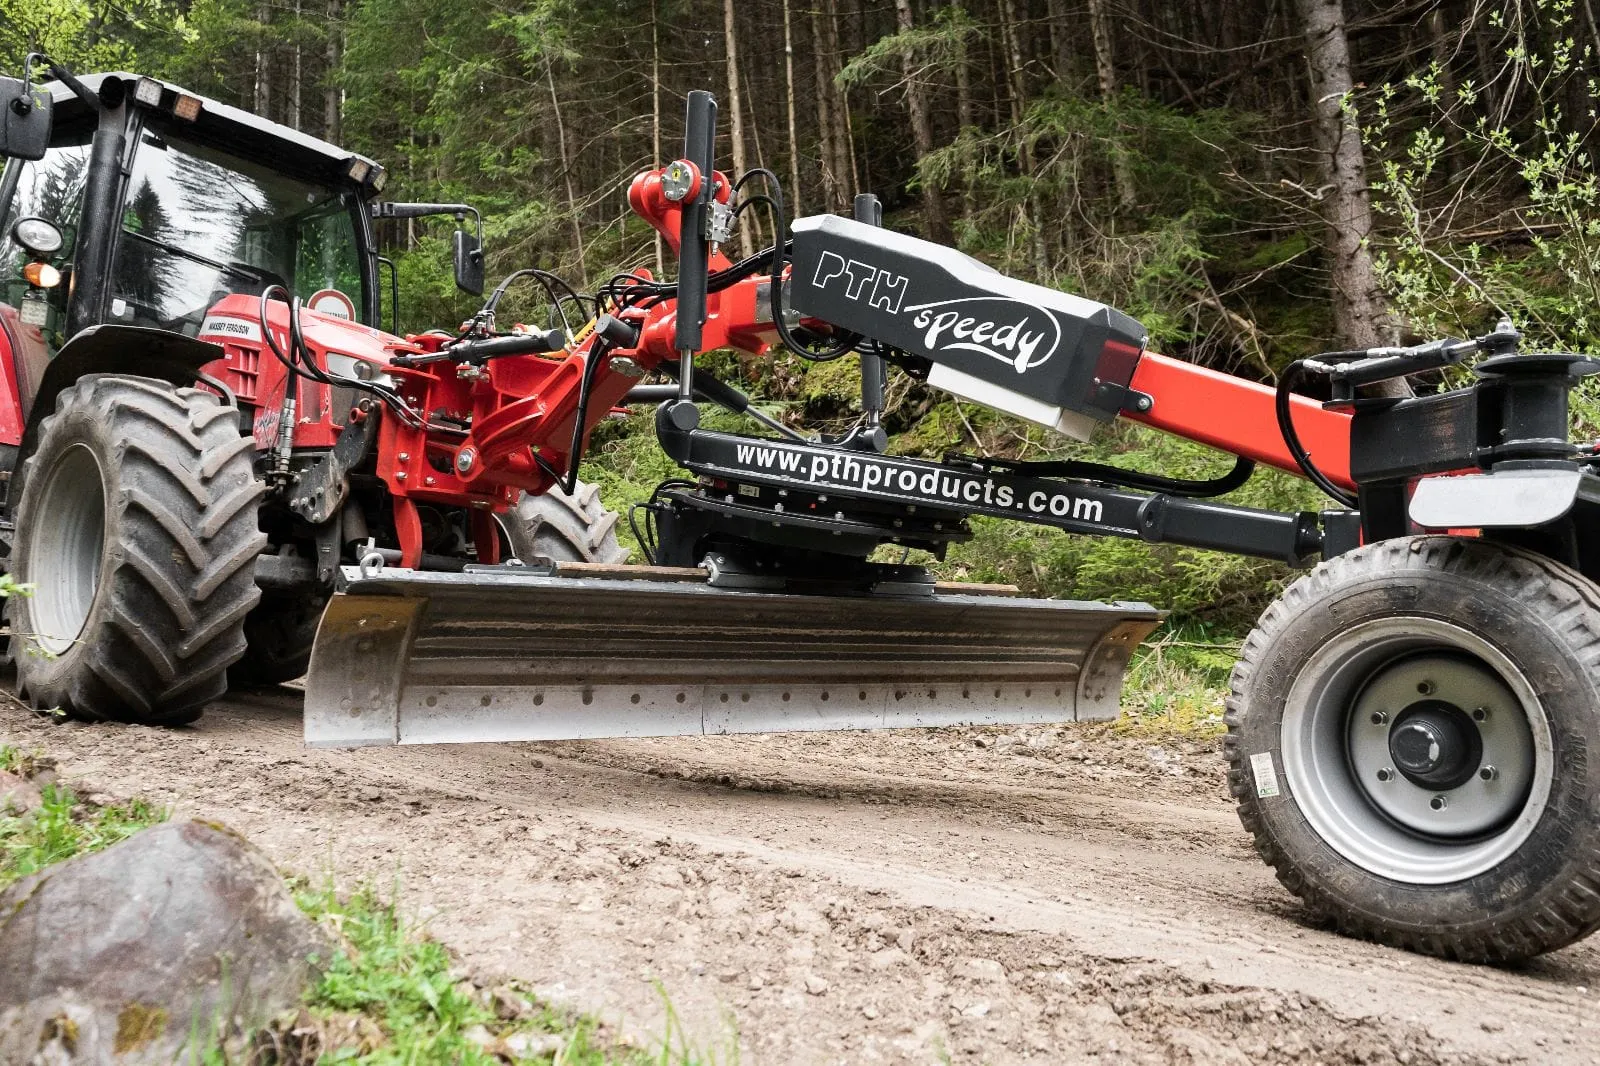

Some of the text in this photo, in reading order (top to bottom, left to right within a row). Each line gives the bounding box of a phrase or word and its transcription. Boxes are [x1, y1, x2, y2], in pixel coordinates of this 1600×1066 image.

[811, 250, 909, 315] PTH
[208, 322, 250, 336] MASSEY FERGUSON
[913, 309, 1046, 374] speedy
[736, 443, 1104, 523] www.pthproducts.com
